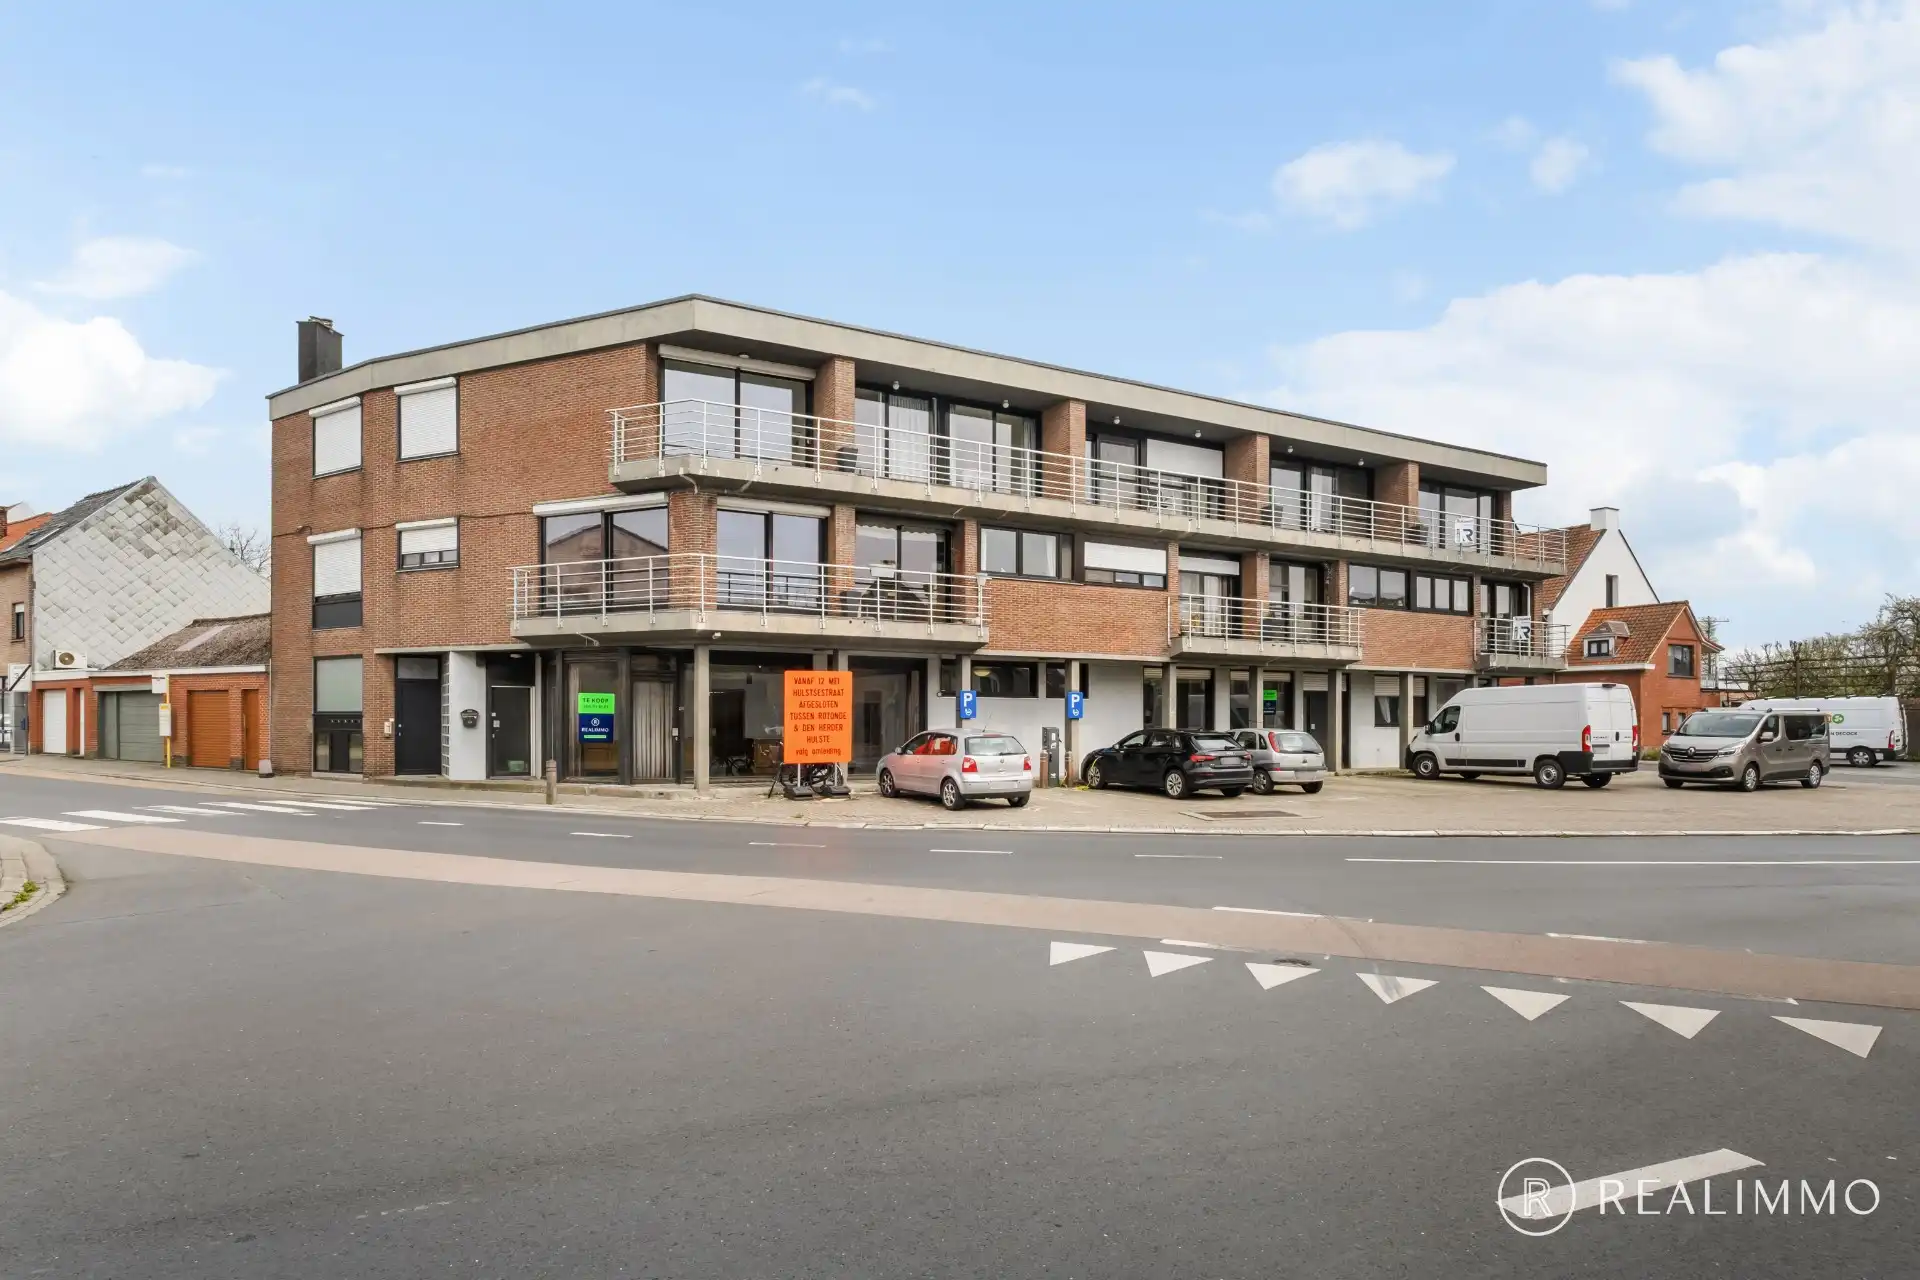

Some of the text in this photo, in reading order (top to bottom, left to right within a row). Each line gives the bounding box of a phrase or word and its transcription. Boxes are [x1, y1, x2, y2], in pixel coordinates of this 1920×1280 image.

[794, 677, 840, 685] VANAF 12 MEI
[792, 688, 844, 697] HULSTSESTRAAT
[798, 700, 839, 708] AFGESLOTEN
[963, 692, 973, 707] P
[1071, 694, 1080, 708] P
[790, 712, 847, 720] TUSSEN ROTONDE
[793, 724, 844, 732] & DEN HERDER
[806, 735, 830, 744] HULSTE
[795, 747, 842, 756] volg omleiding
